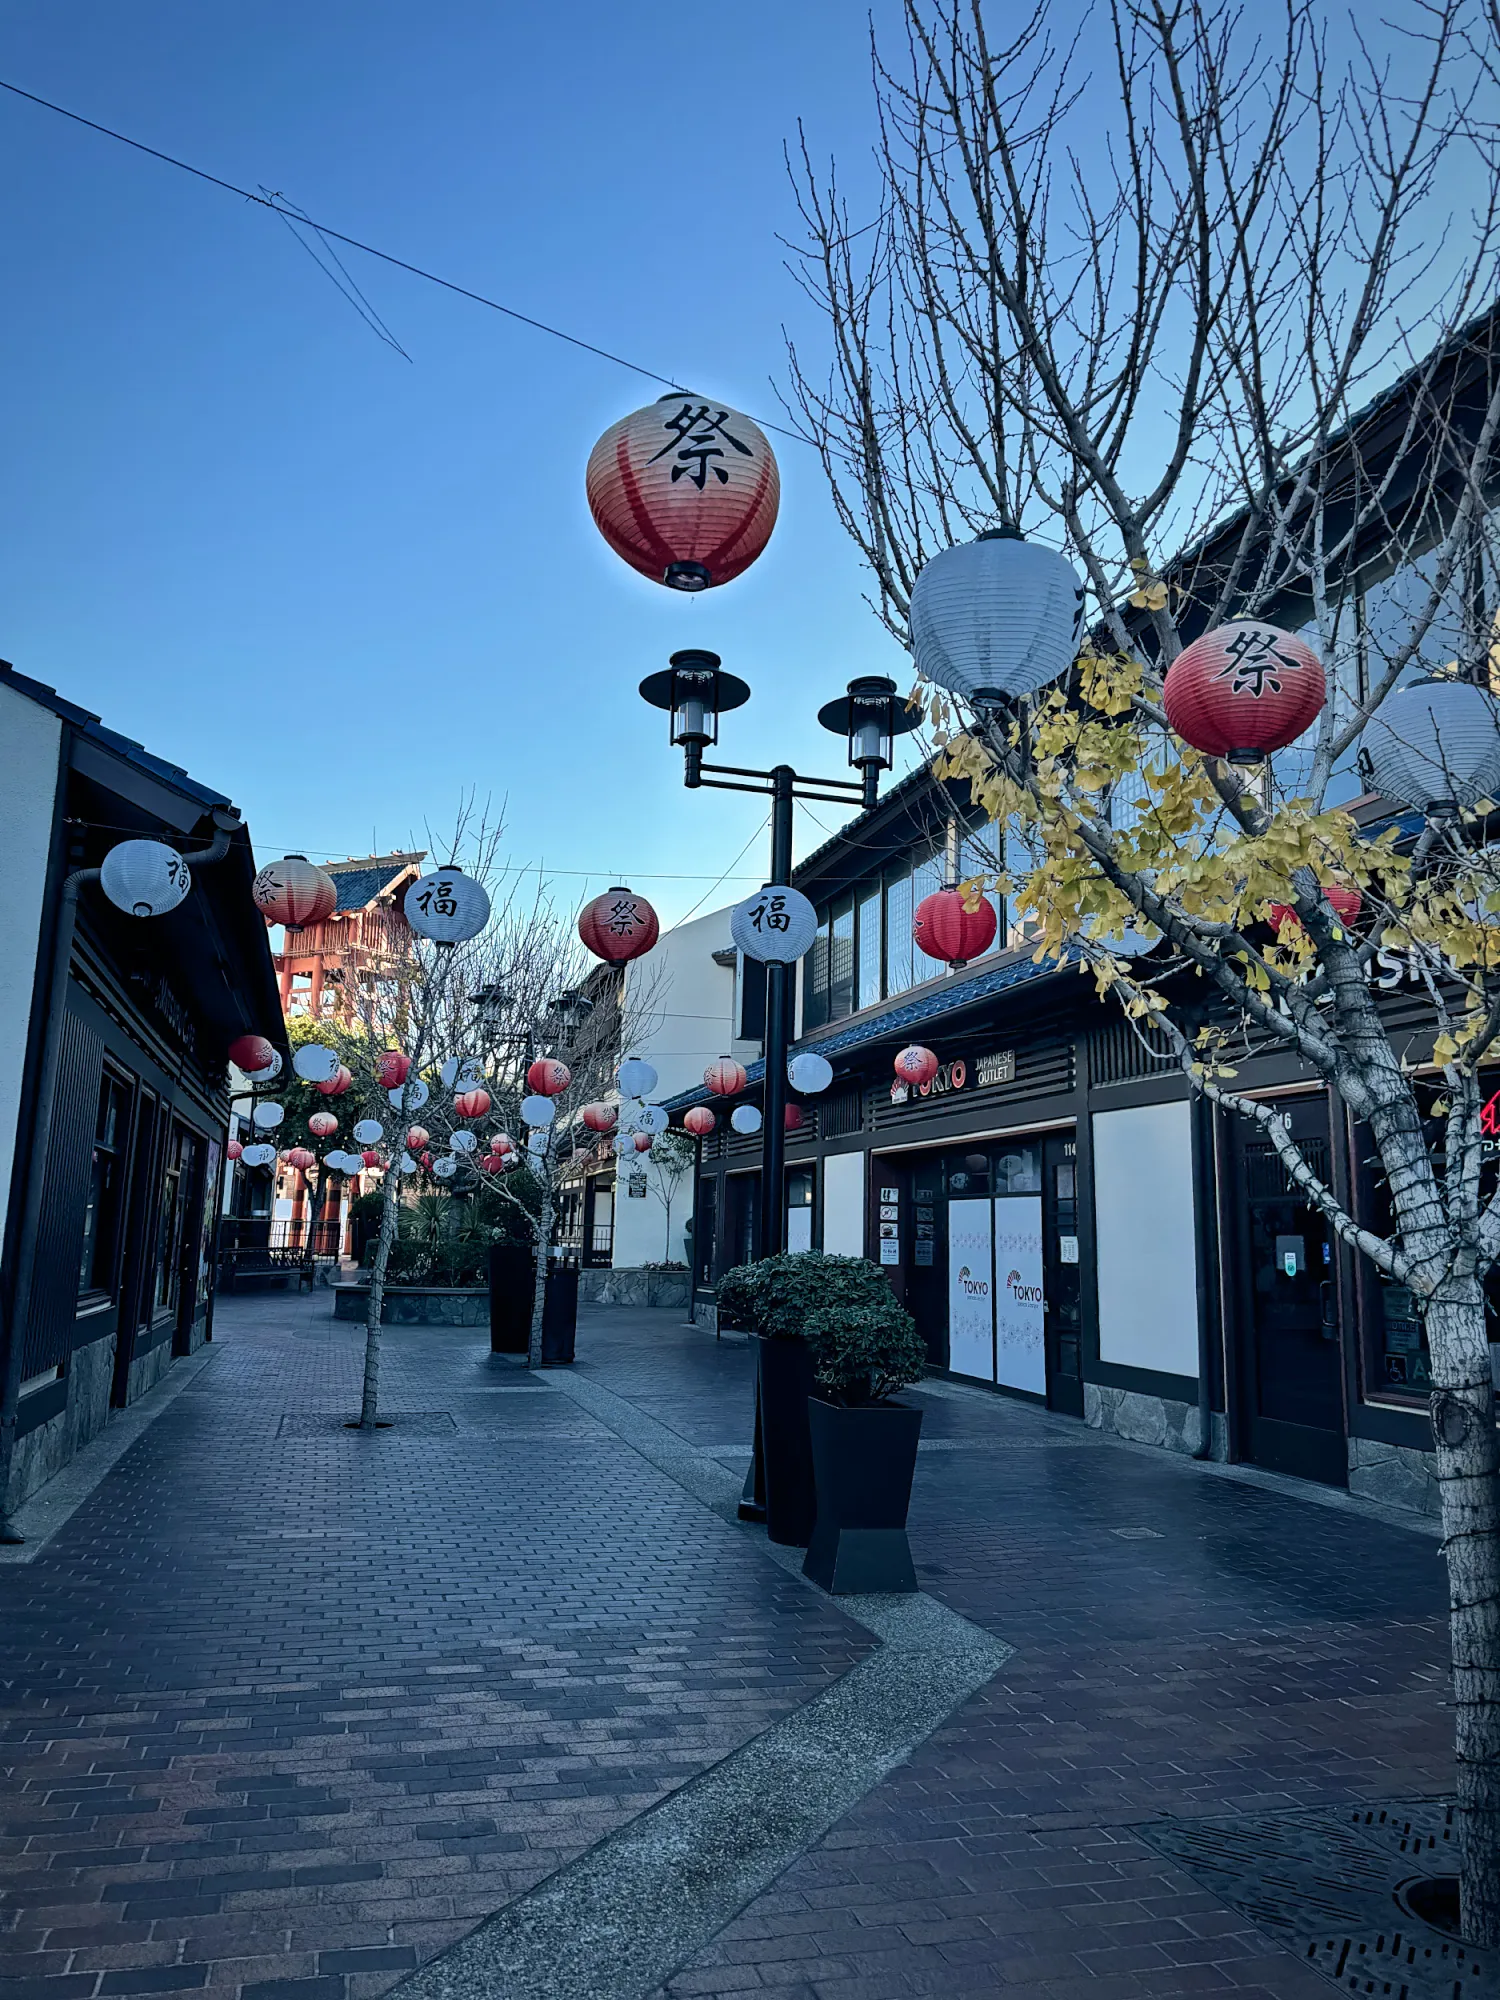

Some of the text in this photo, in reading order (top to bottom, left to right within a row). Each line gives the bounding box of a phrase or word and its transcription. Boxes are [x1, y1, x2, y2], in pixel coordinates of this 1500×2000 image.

[645, 402, 754, 491] 祭
[1209, 630, 1303, 698] 祭
[254, 869, 283, 905] 祭
[415, 880, 458, 918] 福
[604, 900, 647, 937] 祭
[747, 895, 791, 933] 福
[903, 1051, 923, 1071] 祭
[975, 1050, 1013, 1071] JAPANESE
[551, 1066, 569, 1086] 祭
[978, 1065, 1009, 1085] OUTLET
[602, 1107, 615, 1123] 祭
[638, 1110, 654, 1126] 福
[1064, 1143, 1076, 1157] 114
[963, 1280, 989, 1296] TOKYO
[1013, 1285, 1042, 1302] TOKYO
[1412, 1356, 1428, 1381] A
